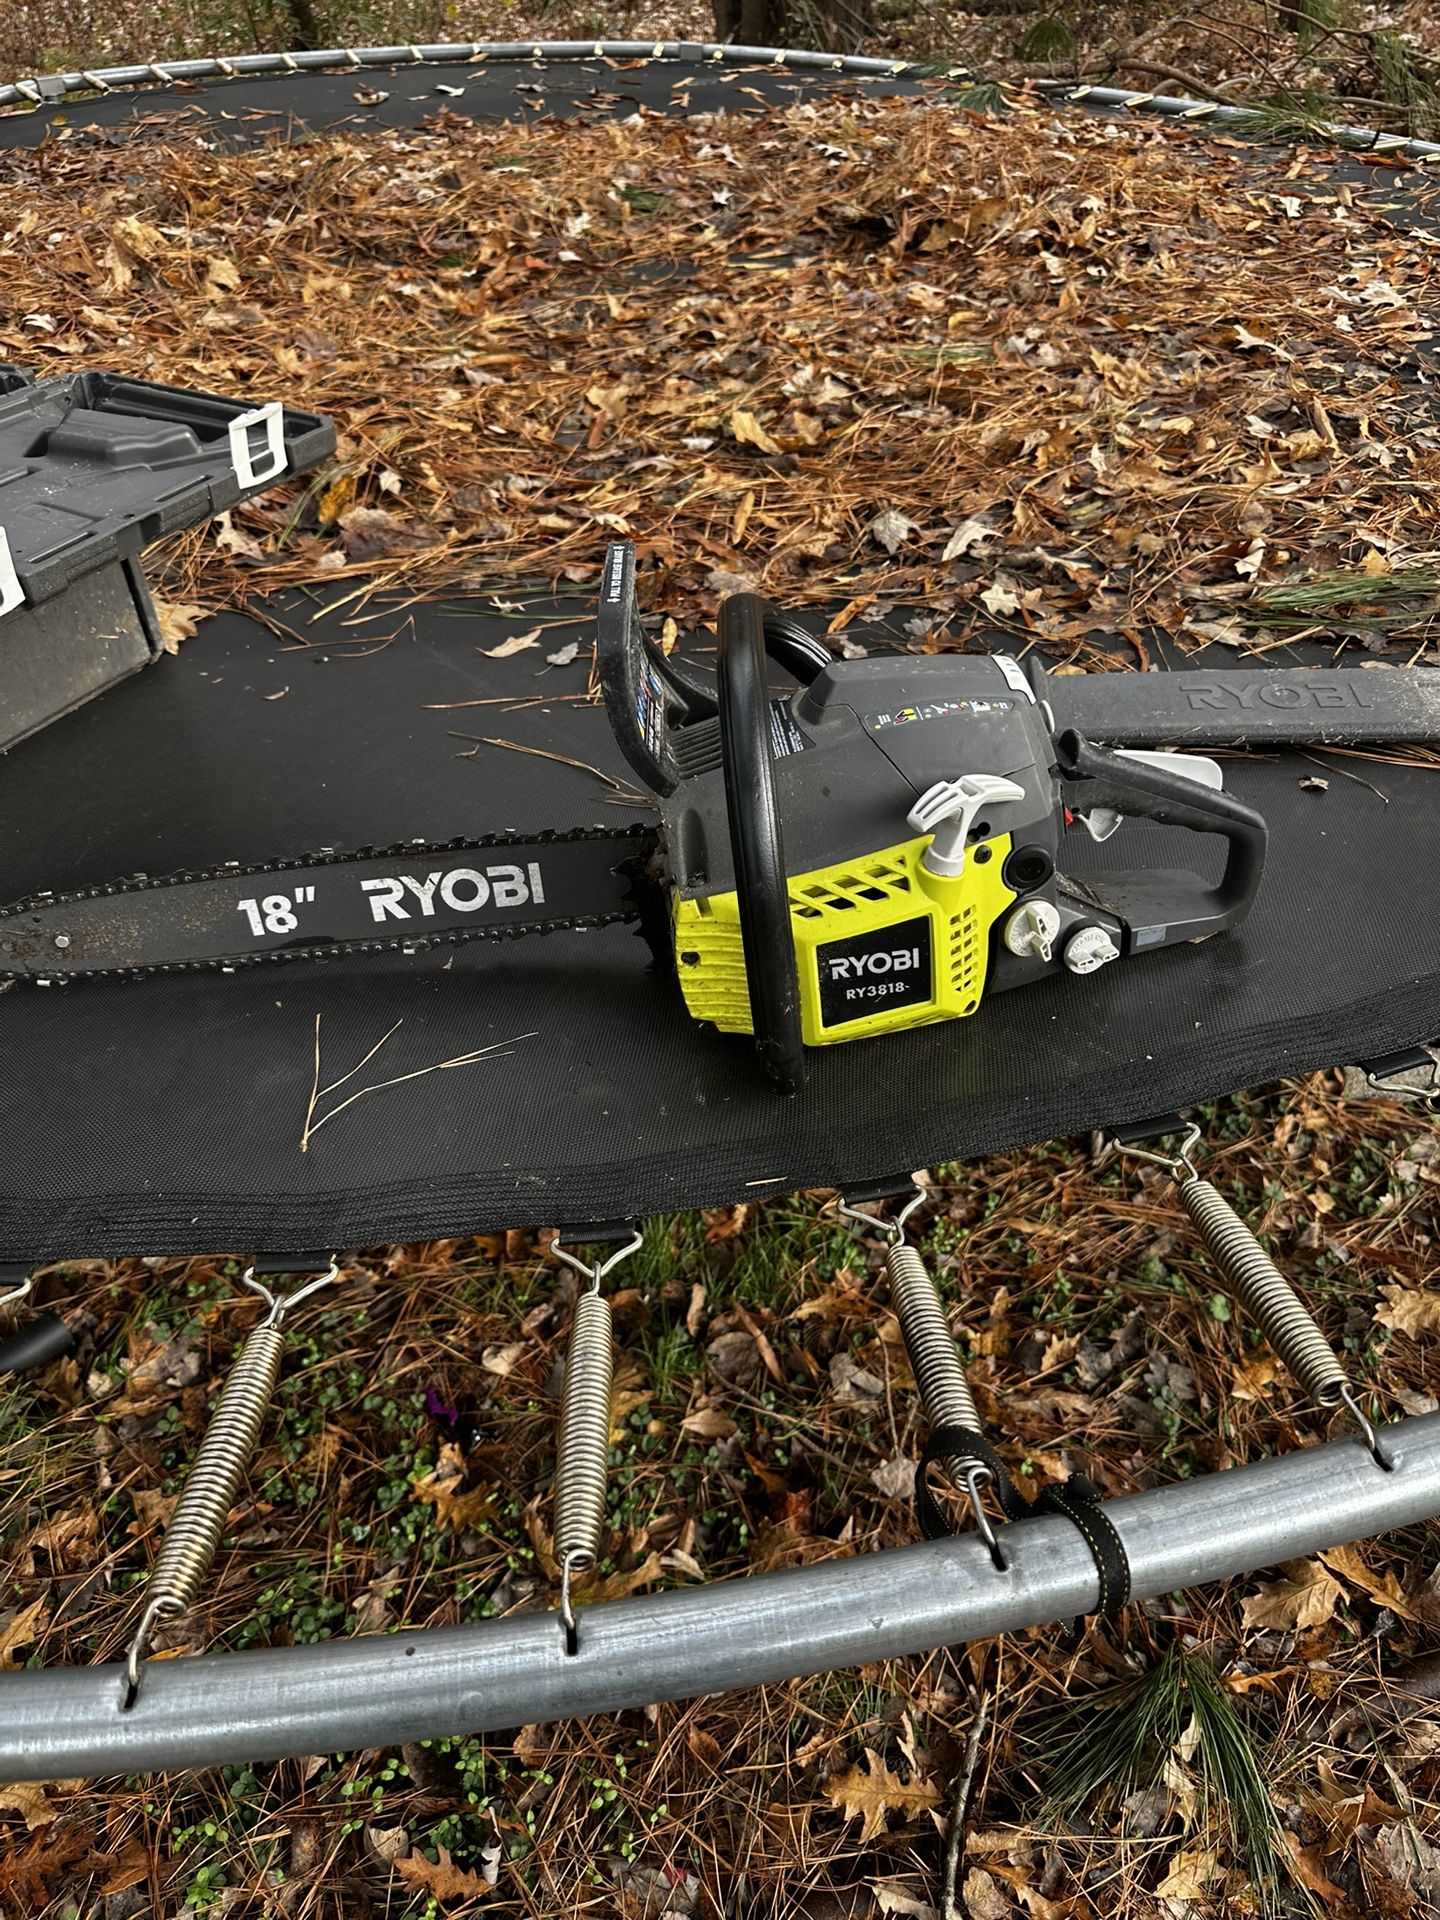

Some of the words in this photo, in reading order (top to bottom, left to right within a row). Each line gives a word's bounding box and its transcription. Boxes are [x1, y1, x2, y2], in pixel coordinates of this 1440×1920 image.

[1178, 682, 1373, 710] RYOBI
[237, 886, 316, 936] 18"
[360, 862, 546, 922] RYOBI
[828, 947, 920, 980] RYOBI
